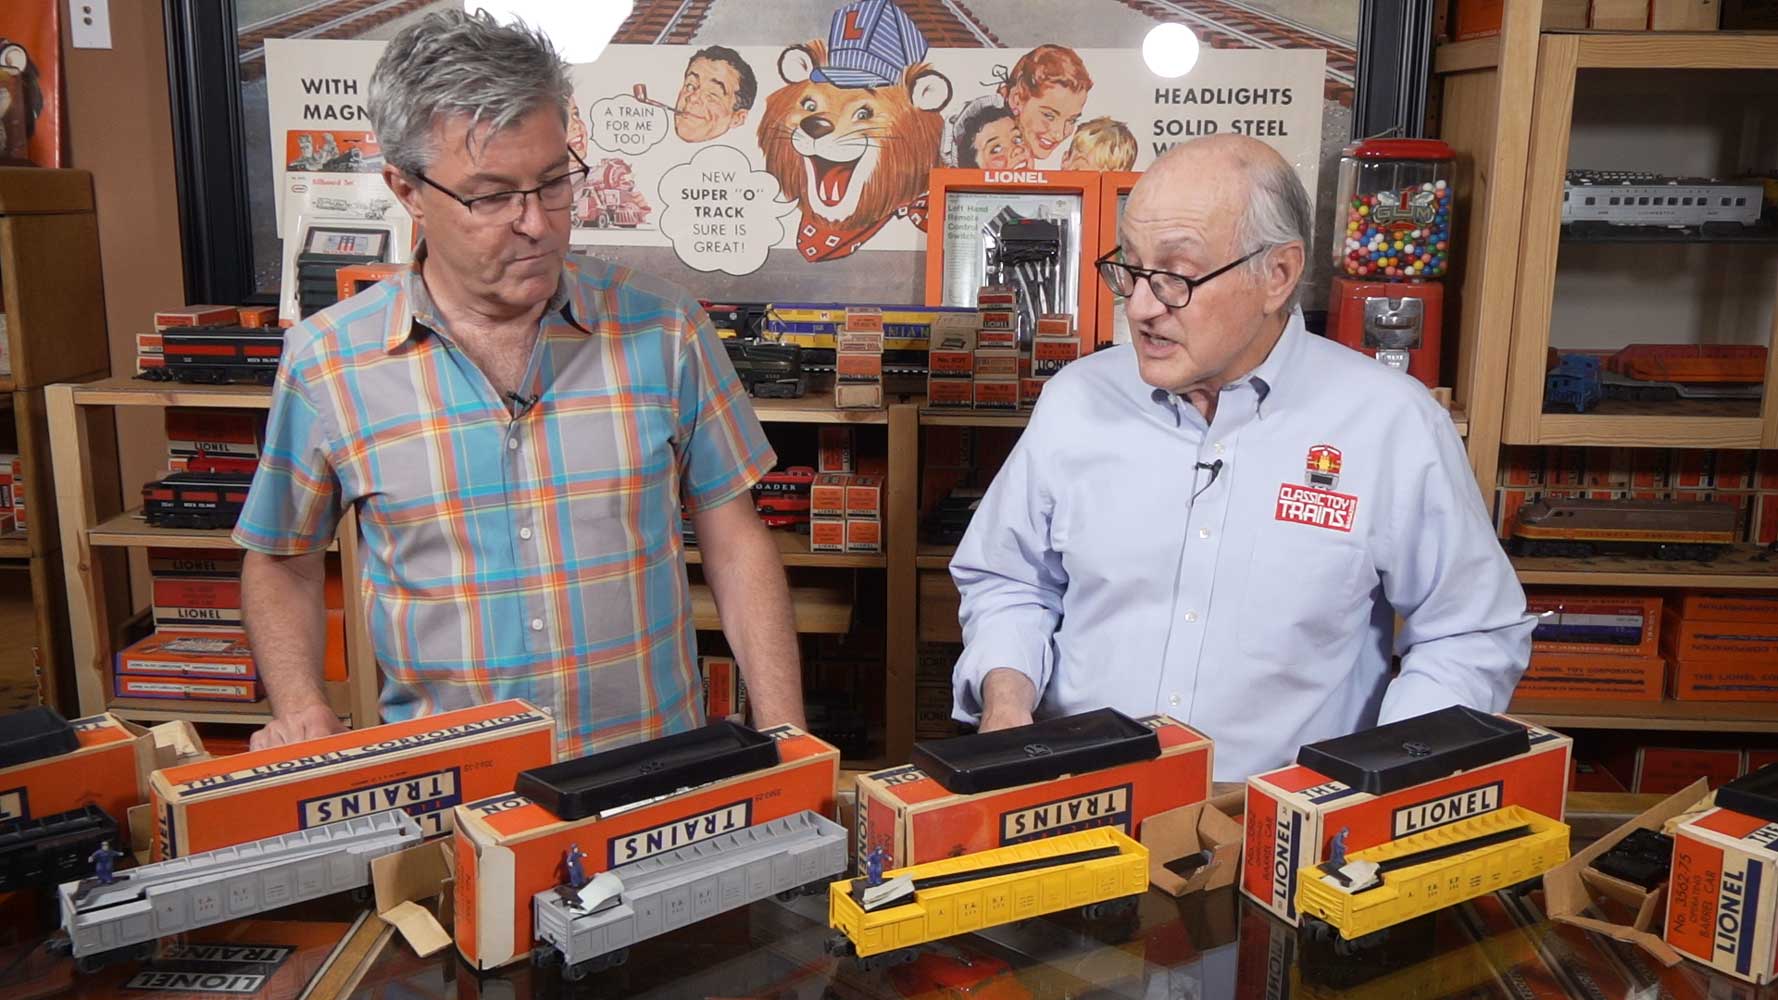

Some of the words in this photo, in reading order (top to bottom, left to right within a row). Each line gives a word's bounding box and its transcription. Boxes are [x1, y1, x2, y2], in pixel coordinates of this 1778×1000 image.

[301, 78, 357, 95] WITH
[1155, 87, 1293, 105] HEADLIGHTS
[605, 107, 613, 117] A
[619, 107, 654, 117] TRAIN
[606, 121, 630, 131] FOR
[635, 121, 653, 131] ME
[1153, 119, 1218, 136] SOLID
[1231, 119, 1288, 136] STEEL
[613, 134, 646, 144] TOO!
[702, 171, 737, 183] NEW
[984, 171, 1048, 184] LIONEL
[681, 188, 728, 201] SUPER
[694, 206, 745, 218] TRACK
[949, 204, 964, 213] Left
[968, 205, 988, 213] Hand
[693, 224, 726, 236] SURE
[735, 224, 746, 236] IS
[694, 241, 746, 253] GREAT!
[194, 442, 231, 452] LIONEL
[1280, 487, 1327, 506] CLASSIC
[1327, 495, 1350, 510] TOY
[1278, 499, 1347, 527] TRAINS
[178, 608, 221, 619] LIONEL
[183, 770, 232, 792] THE
[251, 749, 347, 777] LIONEL
[361, 711, 535, 753] CORPORATION
[317, 776, 443, 821] TRAINS
[1301, 783, 1343, 800] THE
[1015, 791, 1117, 834] TRAINS
[1405, 790, 1491, 830] LIONEL
[625, 809, 736, 860] TRAINS
[1274, 820, 1291, 900] LIONEL
[1703, 870, 1716, 894] CAR
[1699, 901, 1713, 939] BARREL
[1716, 870, 1744, 954] LIONEL
[1673, 914, 1687, 934] No.
[139, 974, 258, 991] LIONEL
